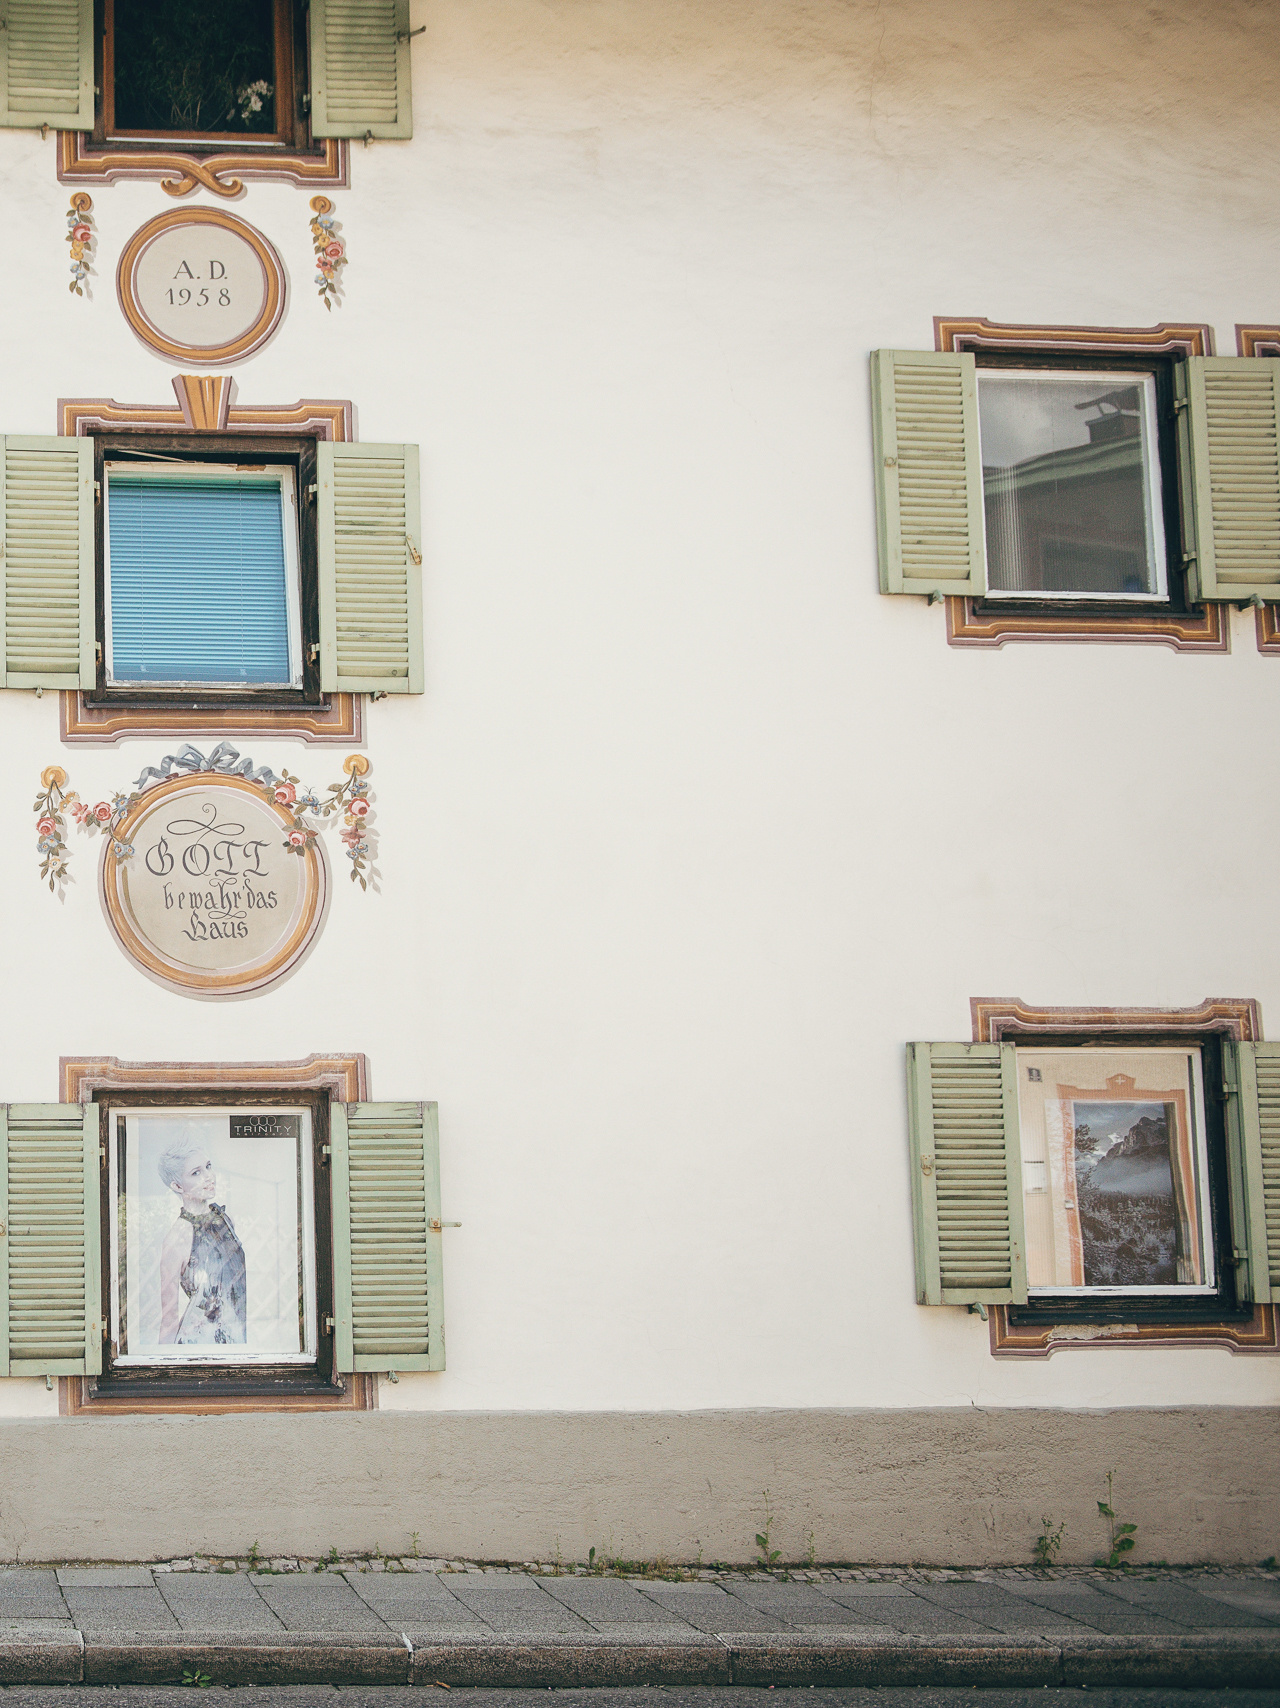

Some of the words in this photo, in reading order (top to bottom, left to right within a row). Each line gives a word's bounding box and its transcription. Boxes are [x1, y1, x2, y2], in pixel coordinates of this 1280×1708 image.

[164, 287, 231, 307] 1958
[144, 834, 272, 877] GOTT
[244, 878, 278, 909] das
[181, 910, 249, 941] Haus
[234, 1125, 292, 1133] TRINITY
